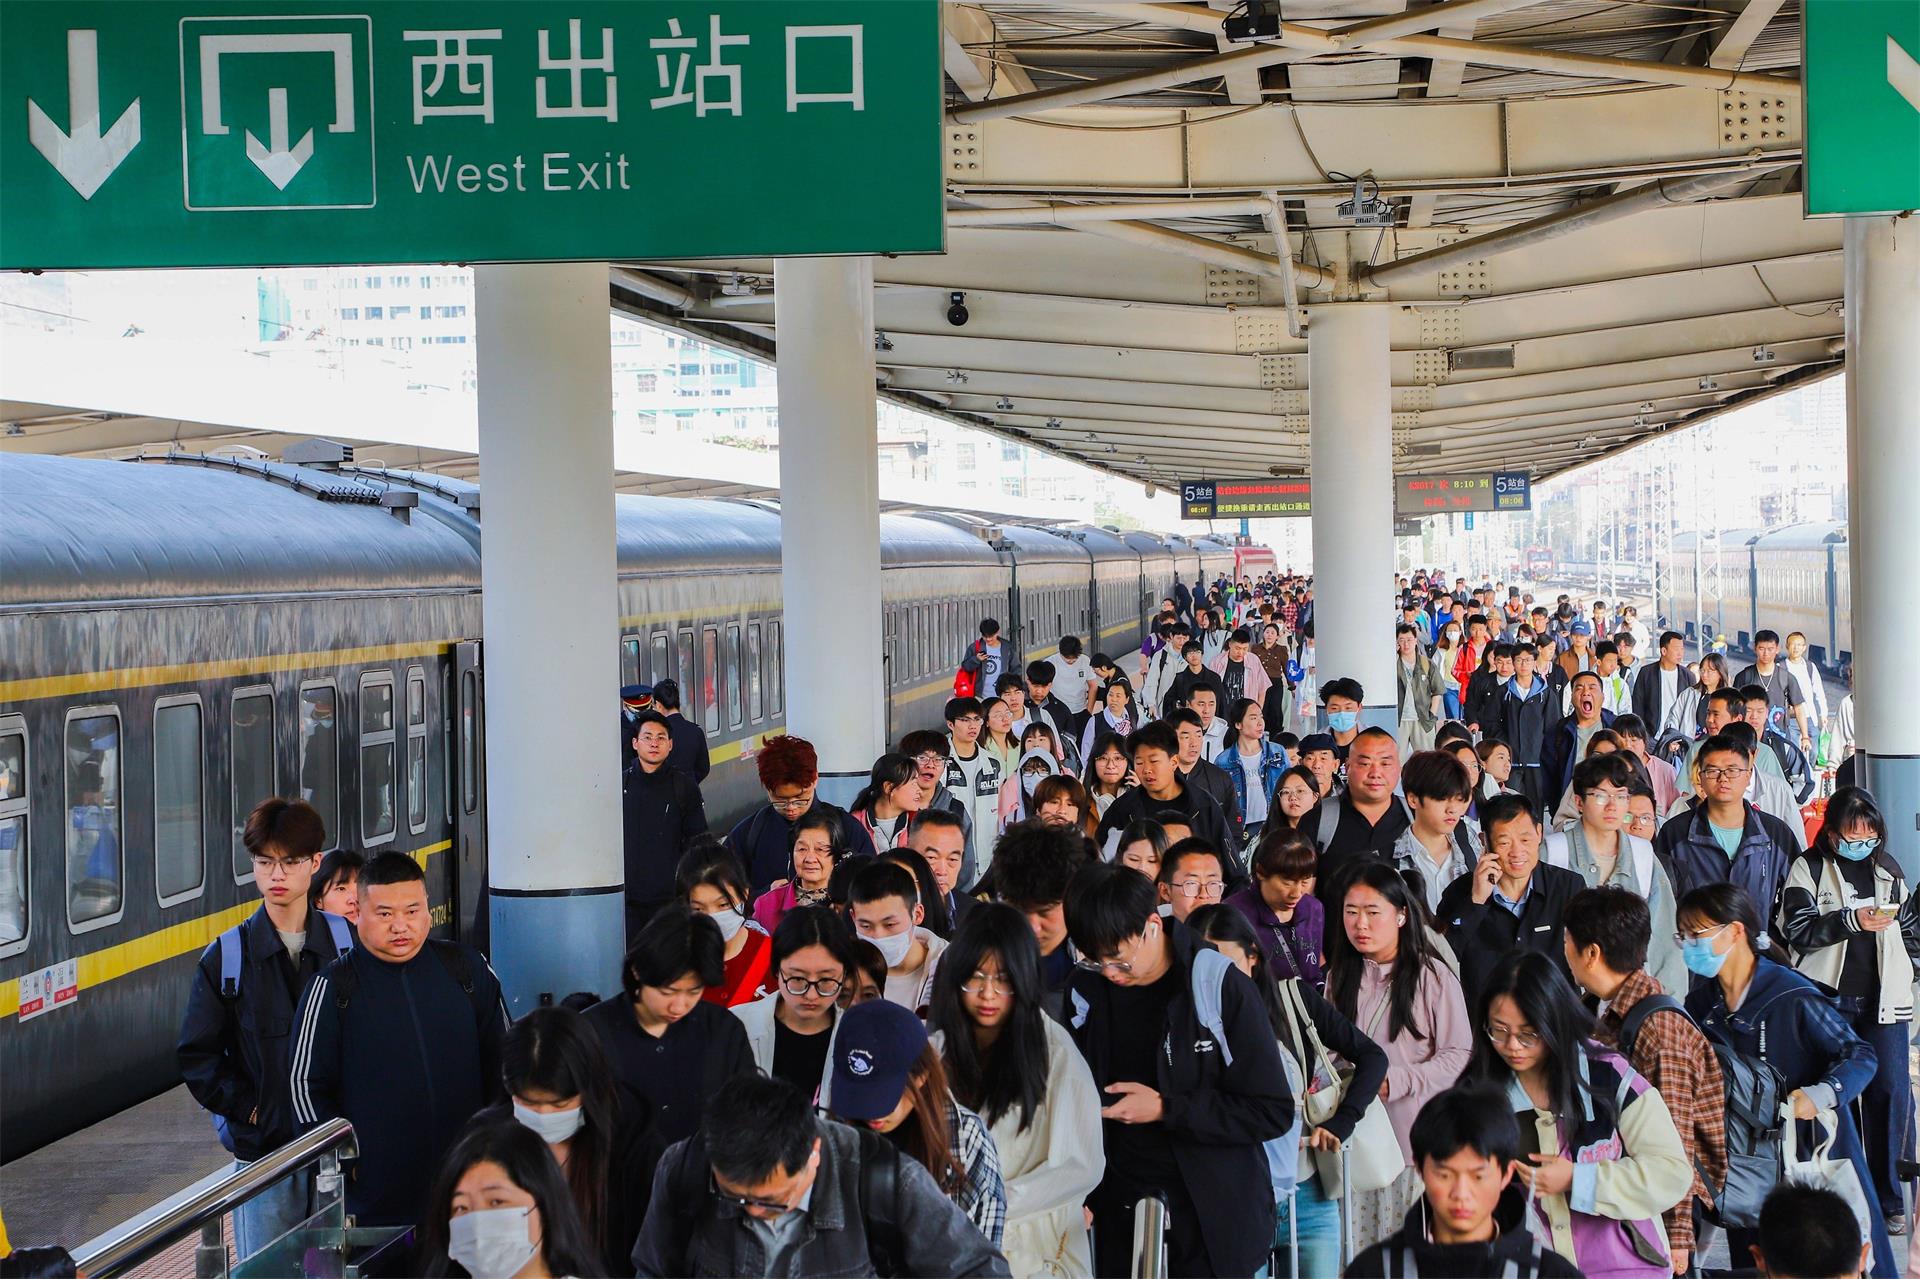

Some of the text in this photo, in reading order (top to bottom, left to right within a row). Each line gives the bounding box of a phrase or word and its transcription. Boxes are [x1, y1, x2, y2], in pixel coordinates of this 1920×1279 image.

[403, 14, 865, 125] 西出站口
[406, 152, 630, 193] West Exit
[1453, 480, 1475, 489] 8:10
[1496, 477, 1525, 493] 5 站台
[1185, 486, 1195, 501] 5
[1196, 487, 1213, 496] 站台
